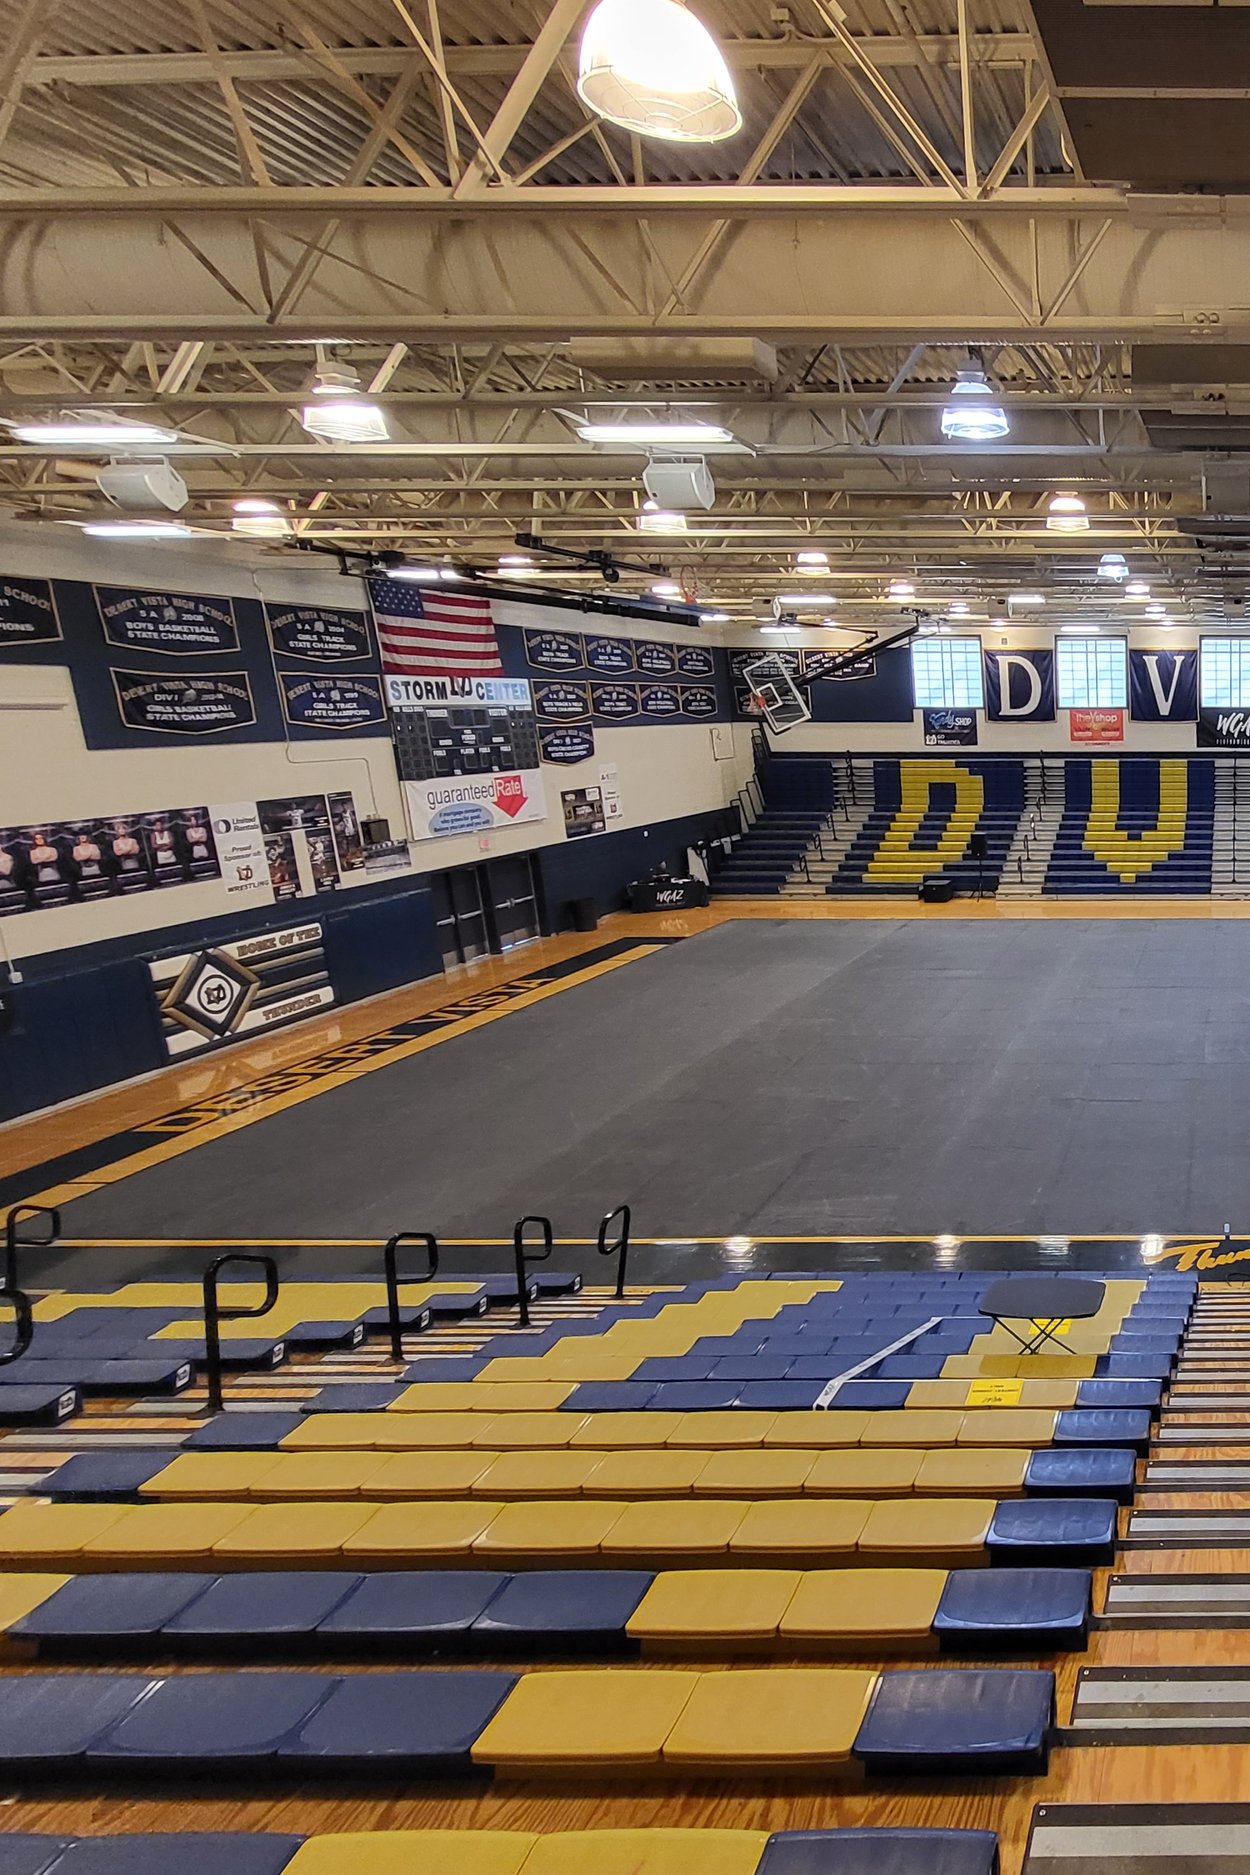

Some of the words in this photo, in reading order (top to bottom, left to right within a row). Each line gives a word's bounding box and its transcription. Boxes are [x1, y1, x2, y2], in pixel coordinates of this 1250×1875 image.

[140, 597, 168, 605] VISTA
[171, 598, 194, 610] HIGH
[125, 622, 154, 630] BOYS
[159, 624, 216, 634] BASKETBALL
[128, 631, 159, 639] STATE
[160, 632, 220, 643] CHAMPIONS
[390, 680, 448, 700] STORM
[476, 682, 528, 700] CENTER
[995, 655, 1042, 717] D
[1142, 655, 1182, 717] V
[181, 712, 236, 721] CHAMPIONS
[955, 718, 972, 726] SHOP
[427, 784, 494, 810] guaranteed
[497, 779, 521, 796] Rate
[232, 816, 256, 824] United
[234, 824, 259, 832] Rentals
[224, 853, 251, 862] Sponsor
[228, 880, 269, 892] WRESTLING
[656, 890, 684, 903] WGAZ
[237, 937, 277, 957] HOME
[279, 932, 295, 945] OF
[296, 927, 321, 940] THE
[262, 994, 321, 1020] THUNDER
[131, 1030, 418, 1132] DESERT
[408, 977, 558, 1024] VISTA
